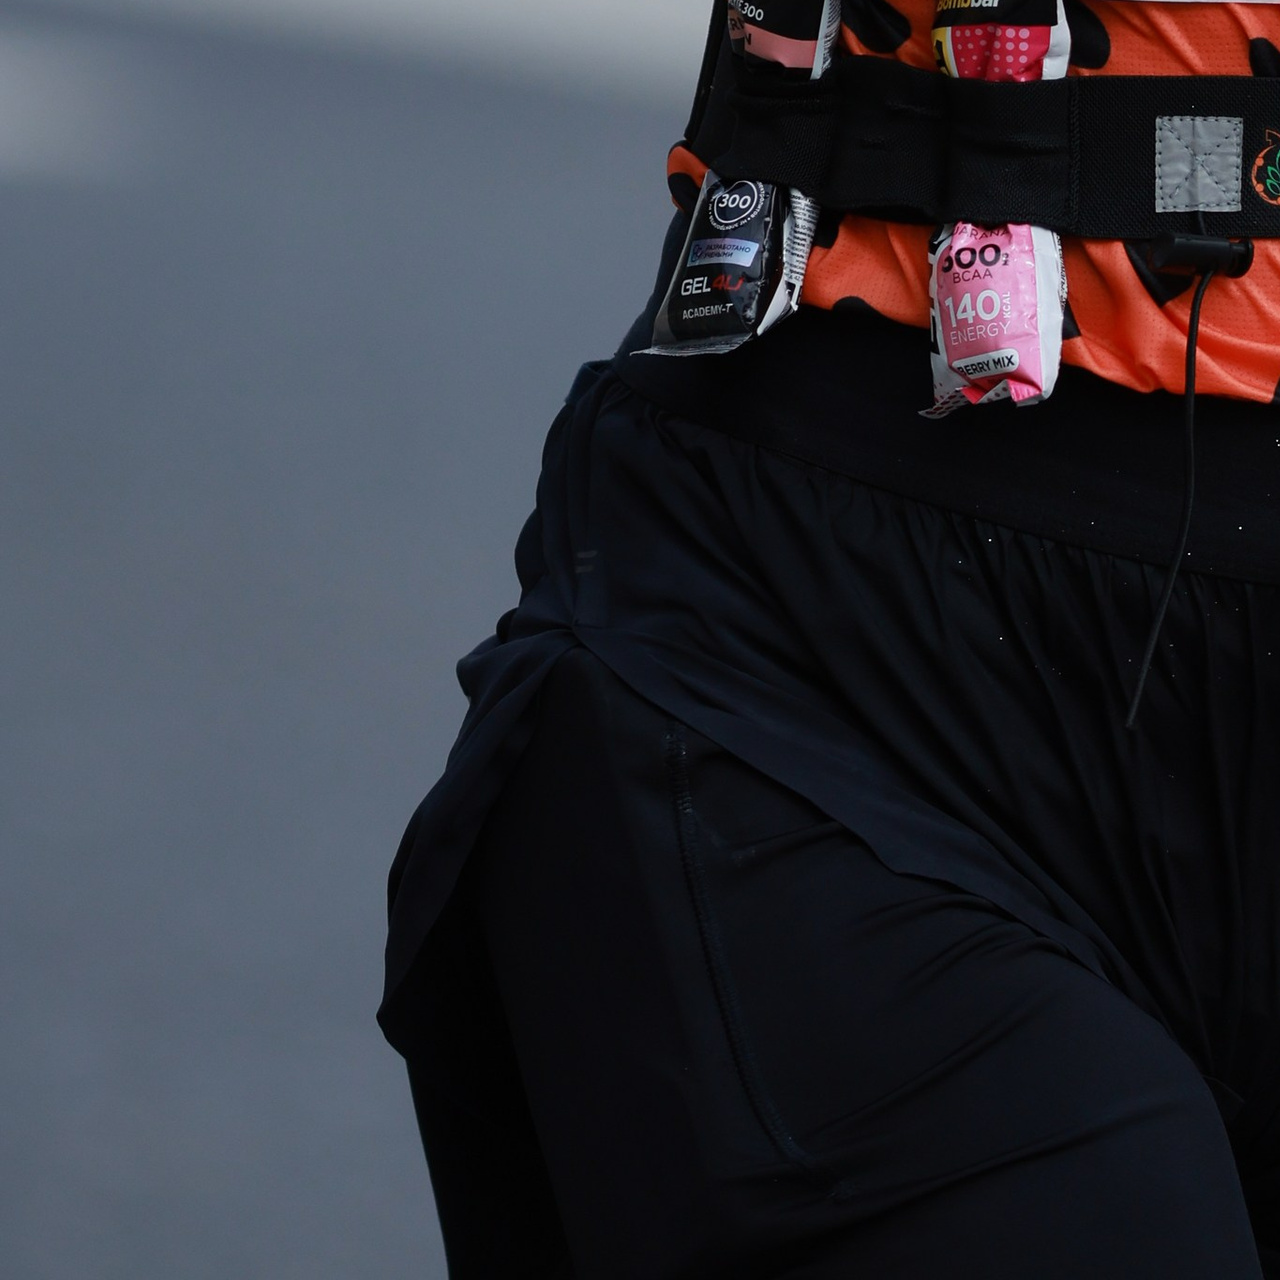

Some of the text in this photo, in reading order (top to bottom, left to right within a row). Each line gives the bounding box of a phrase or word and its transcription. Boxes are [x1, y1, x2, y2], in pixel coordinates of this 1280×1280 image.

[718, 193, 752, 210] 300
[953, 268, 994, 284] BCAA
[944, 289, 1001, 328] 140
[1003, 291, 1011, 320] KCAL
[951, 320, 1011, 346] ENERGY
[957, 355, 1015, 377] BERRY MIX
